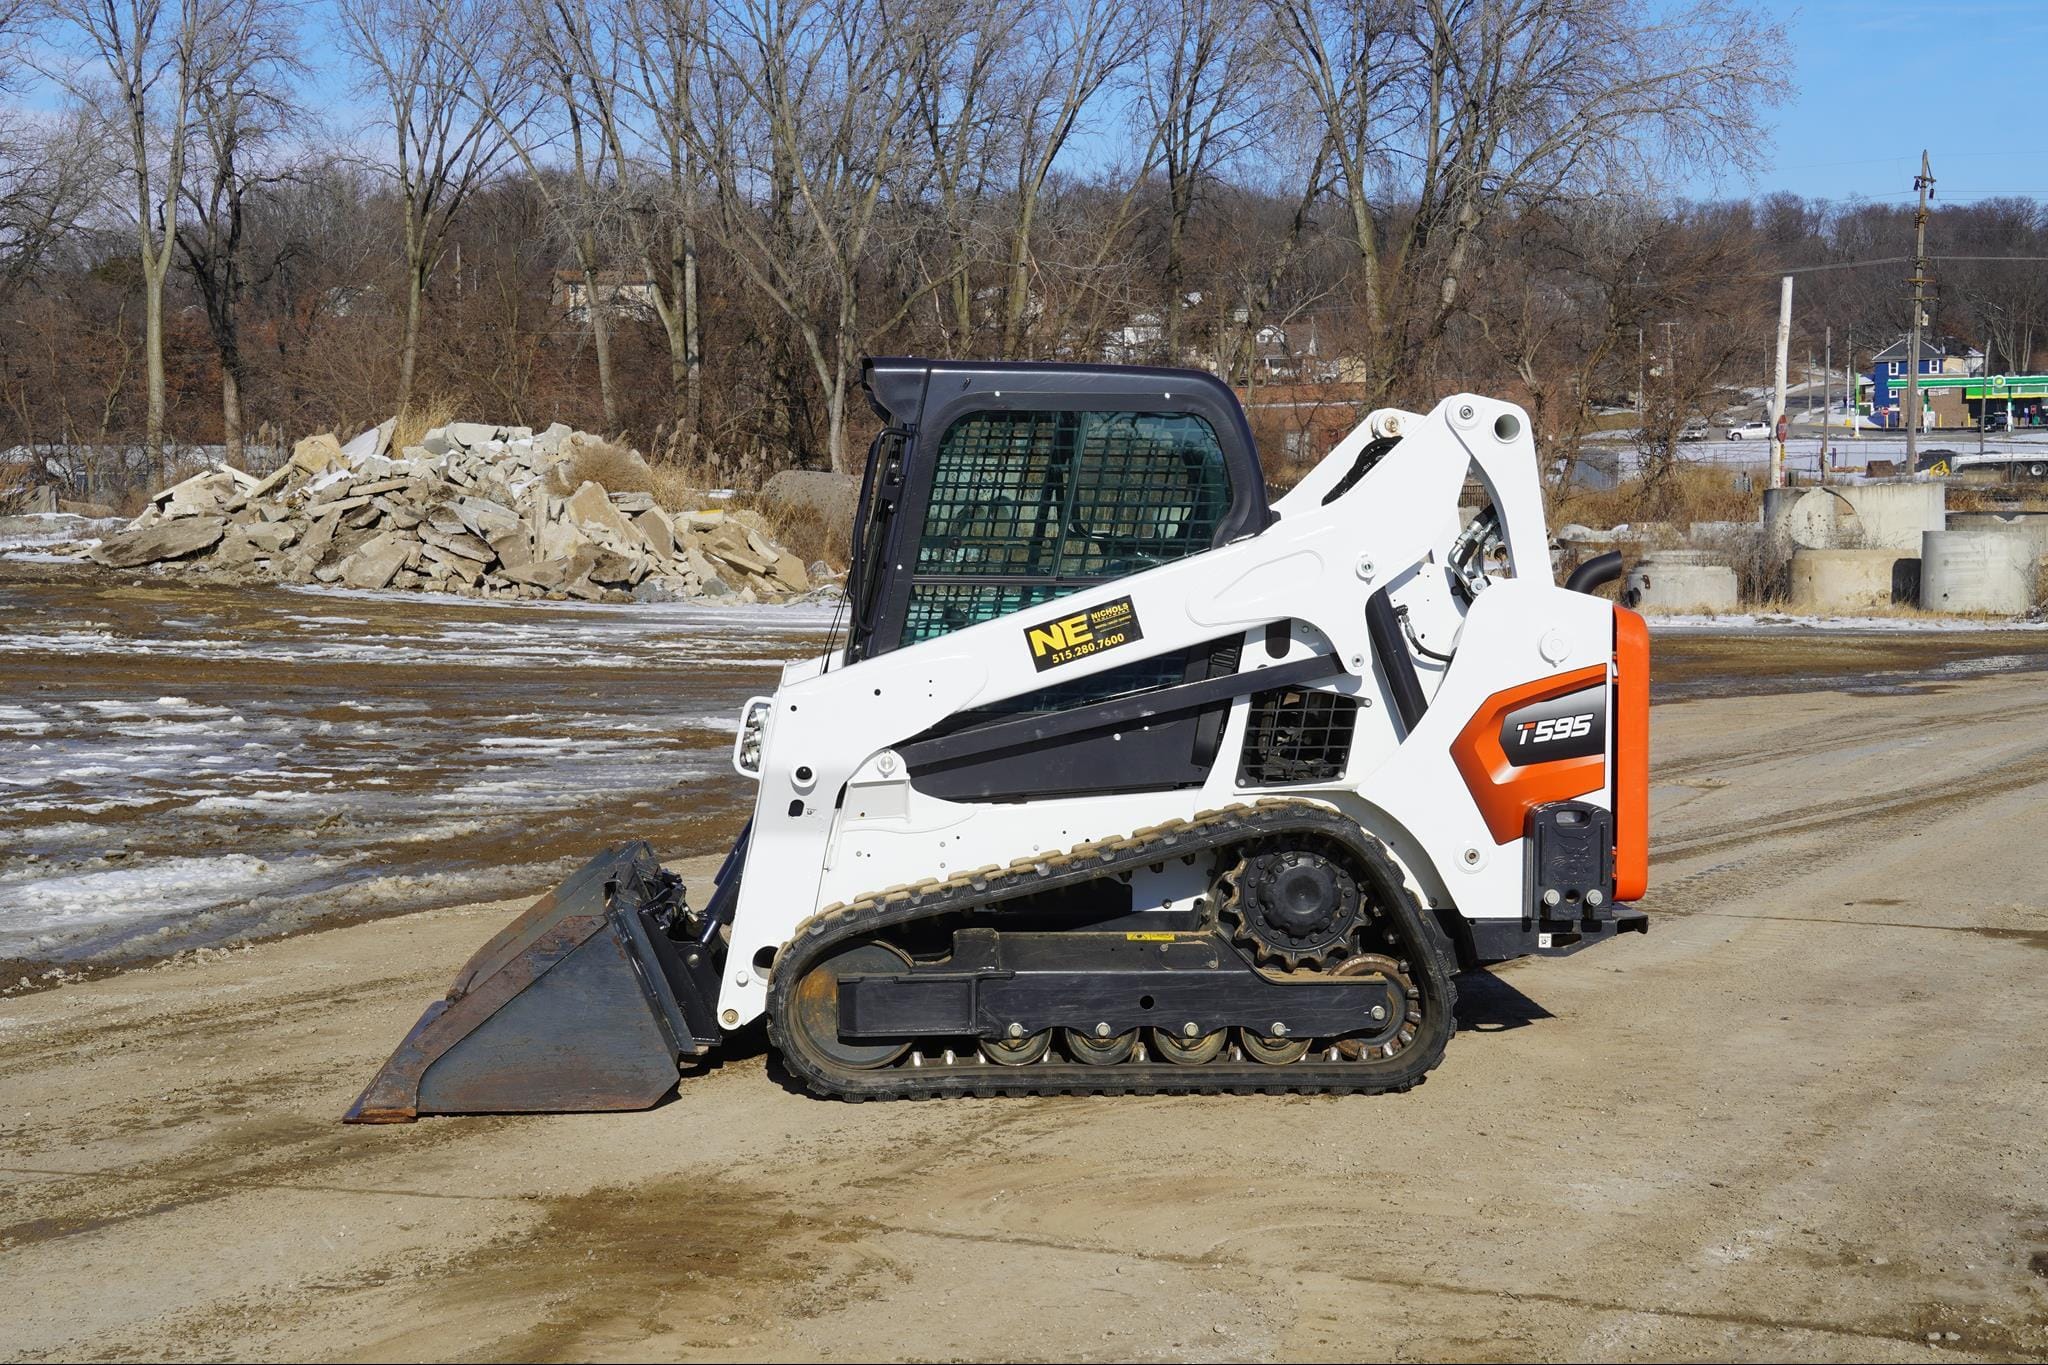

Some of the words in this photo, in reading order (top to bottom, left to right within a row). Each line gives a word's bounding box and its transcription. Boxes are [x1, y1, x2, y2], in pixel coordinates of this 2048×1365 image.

[1091, 602, 1129, 620] NICHOLS
[1029, 613, 1094, 657] NE
[1052, 633, 1125, 664] 515.280.7600
[1517, 713, 1594, 745] T595
